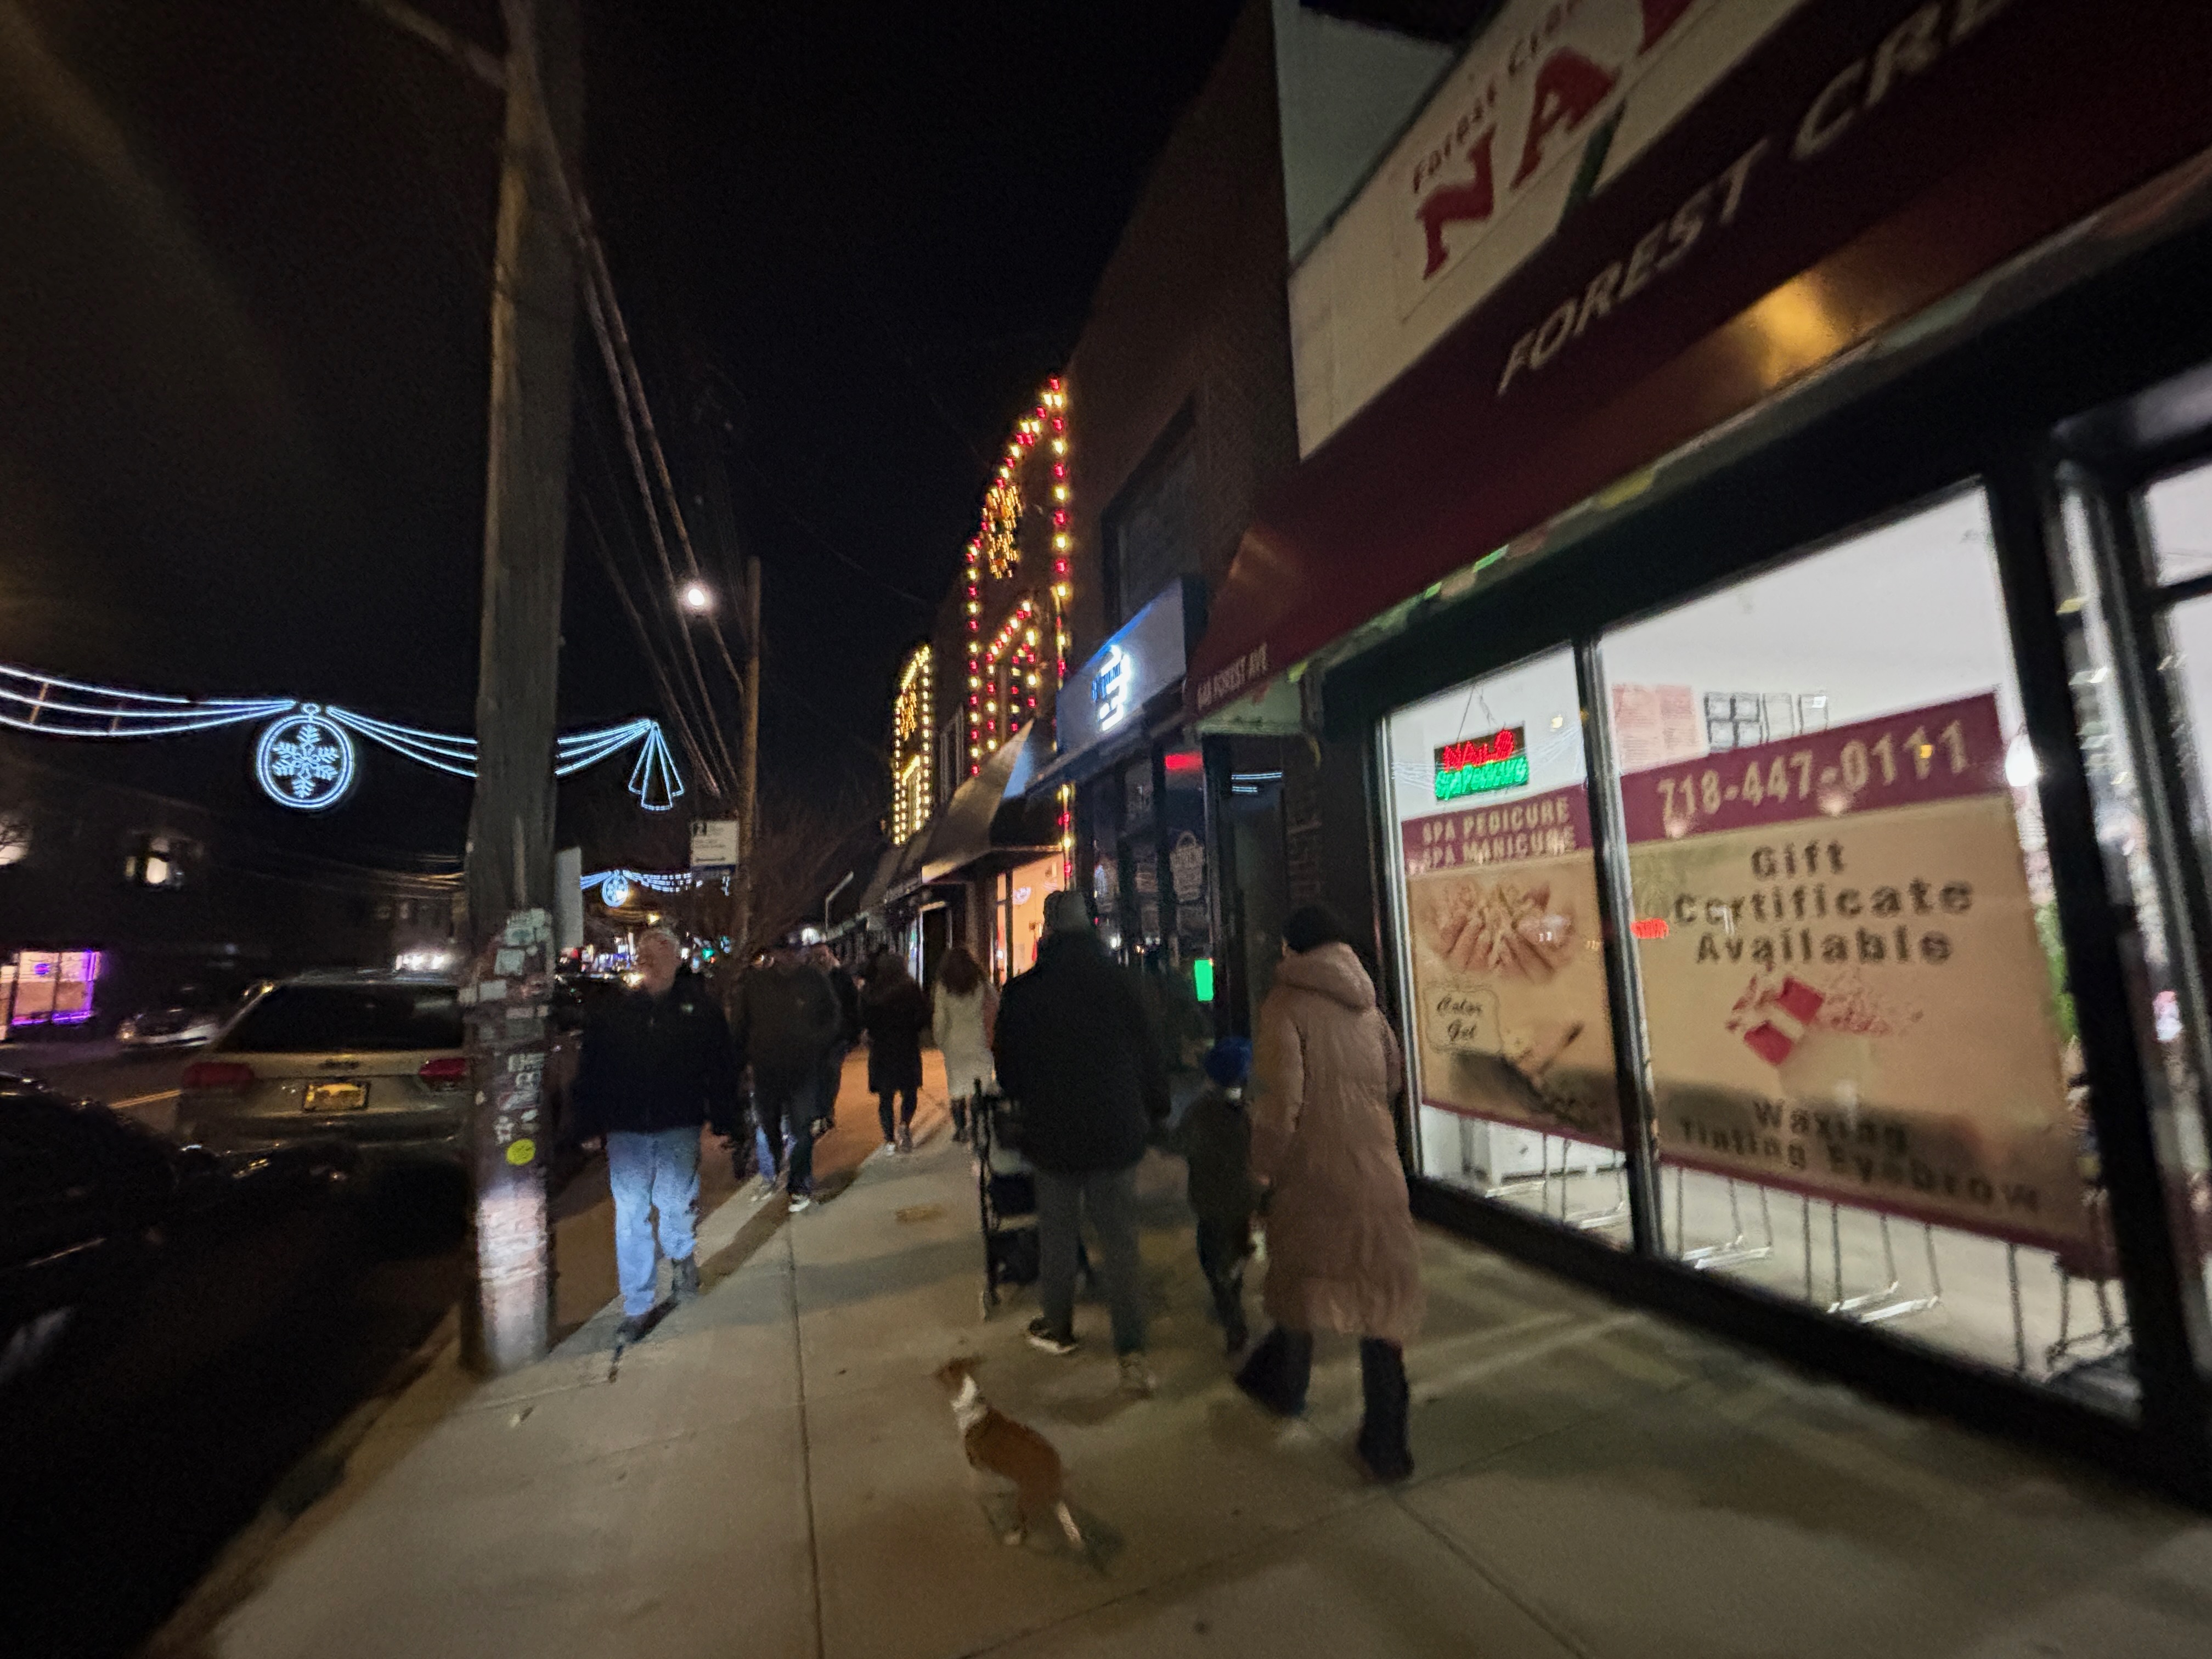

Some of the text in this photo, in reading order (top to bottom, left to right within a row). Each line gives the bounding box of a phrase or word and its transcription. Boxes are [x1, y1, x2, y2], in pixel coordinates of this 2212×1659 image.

[1413, 77, 1498, 195] Forest
[1497, 137, 1771, 397] FOREST
[1443, 729, 1515, 773] NAIL
[1658, 720, 1967, 825] 718-447-0111
[1422, 796, 1570, 845] SPA PEDICURE
[1422, 825, 1576, 868] SPA MANICURE
[1751, 839, 1846, 881] Gift
[1674, 879, 1974, 925] Certificate
[1696, 925, 1953, 965] Available
[1679, 1116, 1807, 1170] Tinting
[1752, 1097, 1909, 1156] Waxing
[1826, 1143, 2042, 1215] Eyebrow
